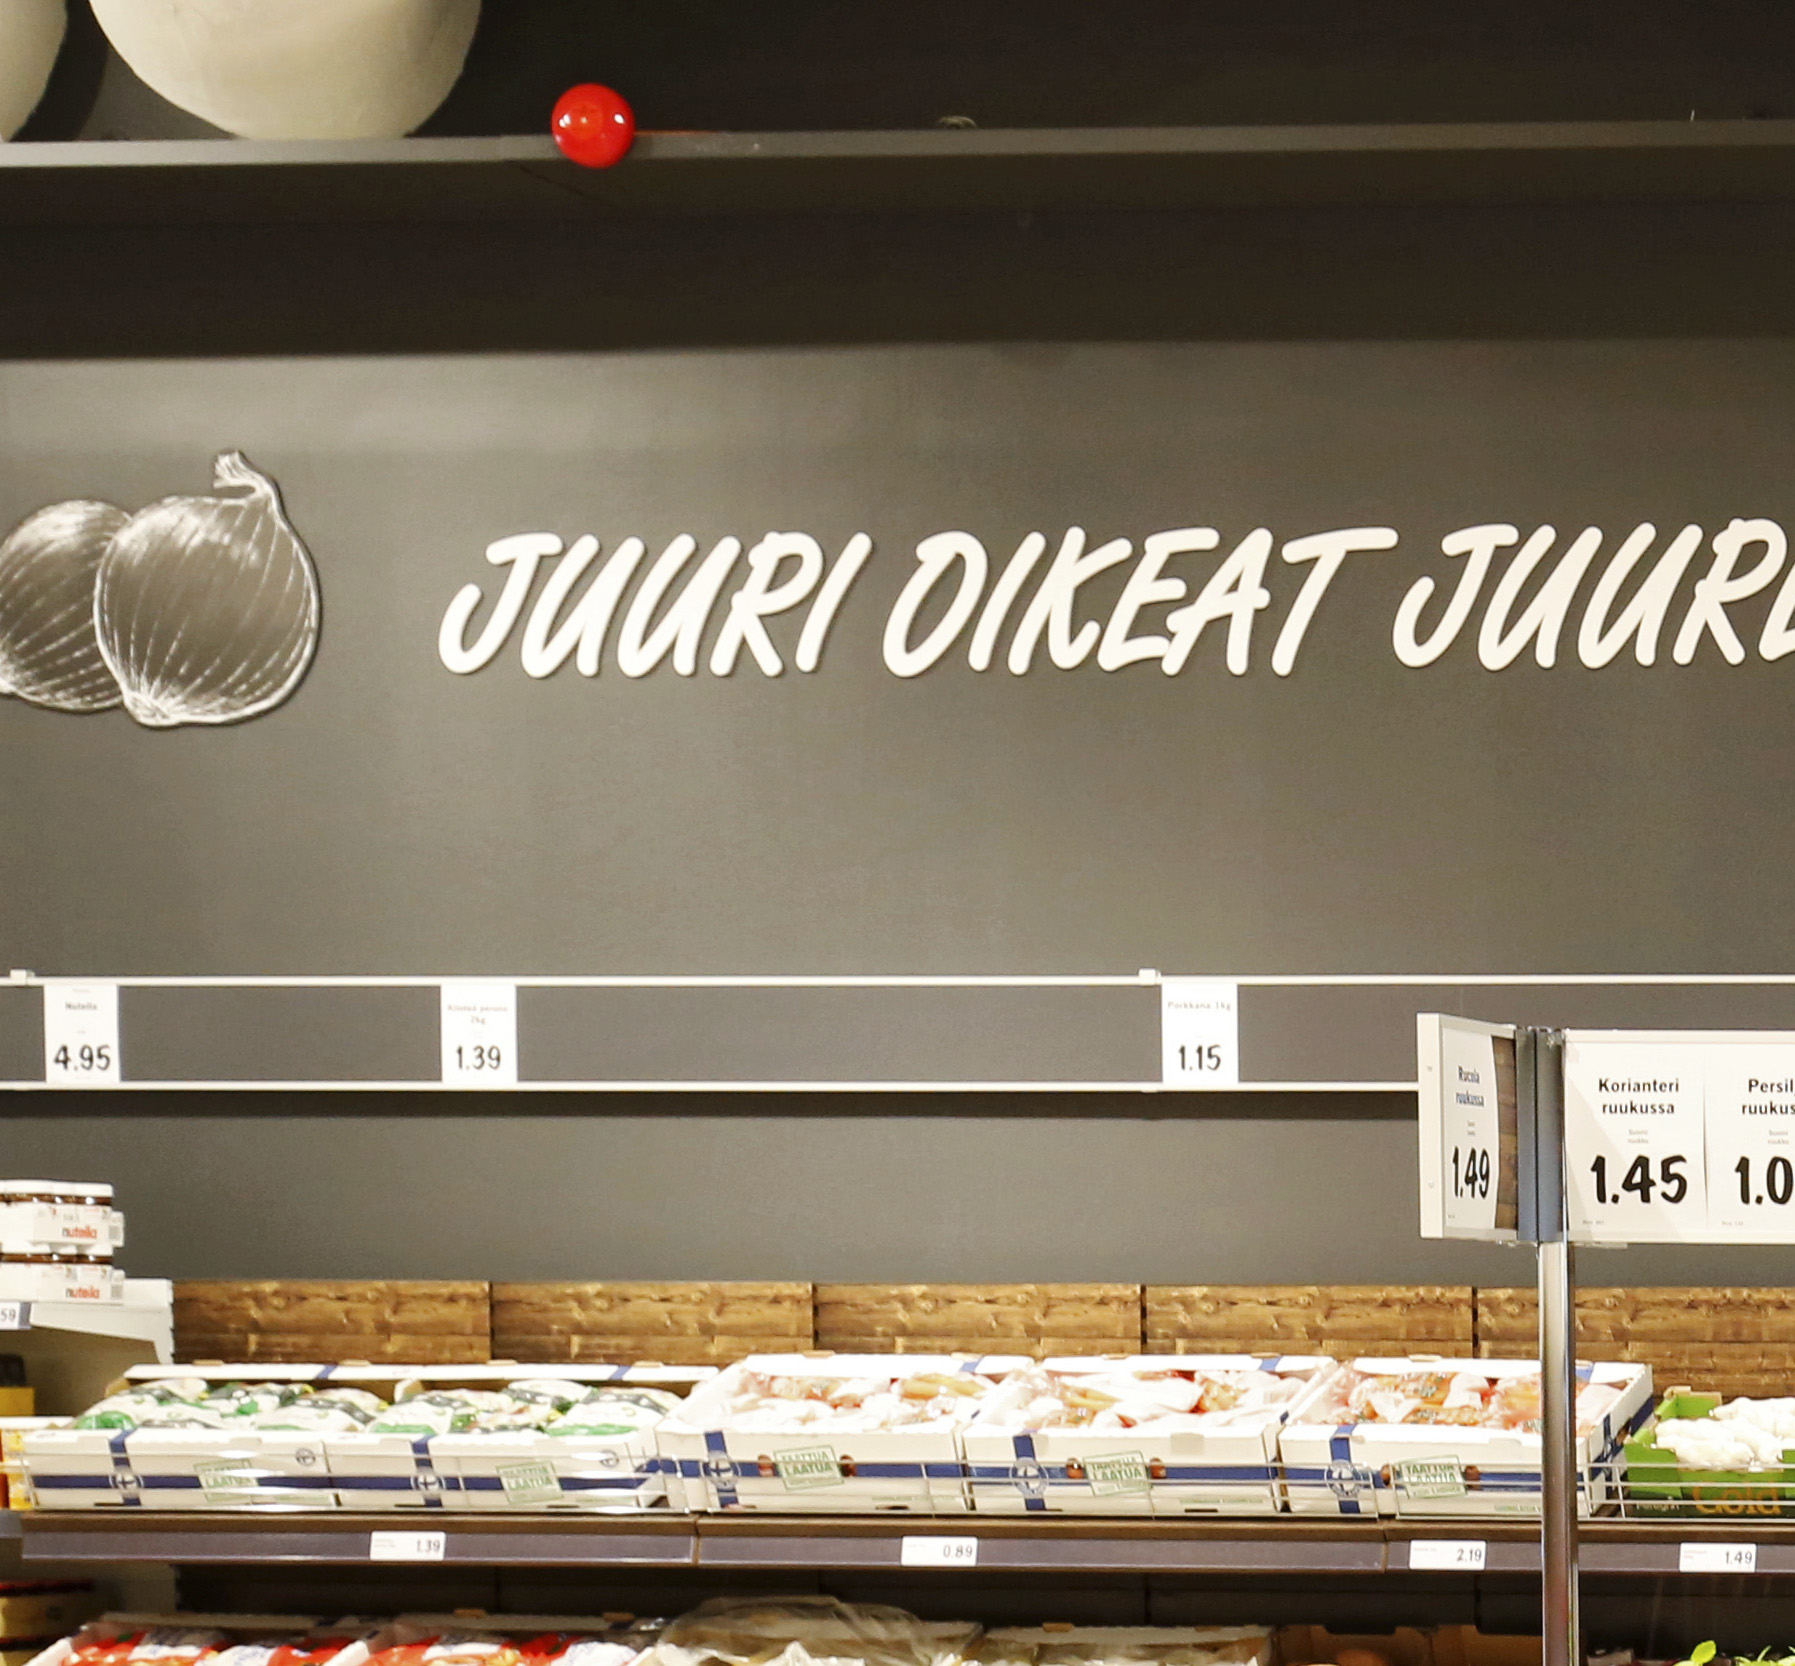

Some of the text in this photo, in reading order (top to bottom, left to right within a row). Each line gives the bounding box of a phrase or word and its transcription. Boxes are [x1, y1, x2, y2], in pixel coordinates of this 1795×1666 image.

[437, 530, 872, 677] JUURI
[882, 526, 1398, 677] OIKEAT
[53, 1045, 111, 1072] 4.95
[456, 1045, 501, 1072] 1.39
[1178, 1044, 1221, 1071] 1.15
[1598, 1078, 1679, 1094] Korianteri
[1602, 1101, 1675, 1116] ruukussa
[1452, 1146, 1490, 1199] 1.49
[1590, 1154, 1688, 1204] 1.45
[415, 1539, 442, 1555] 1.39
[943, 1544, 974, 1560] 0.89
[1456, 1547, 1484, 1564] 2.19
[1724, 1549, 1754, 1566] 1.49
